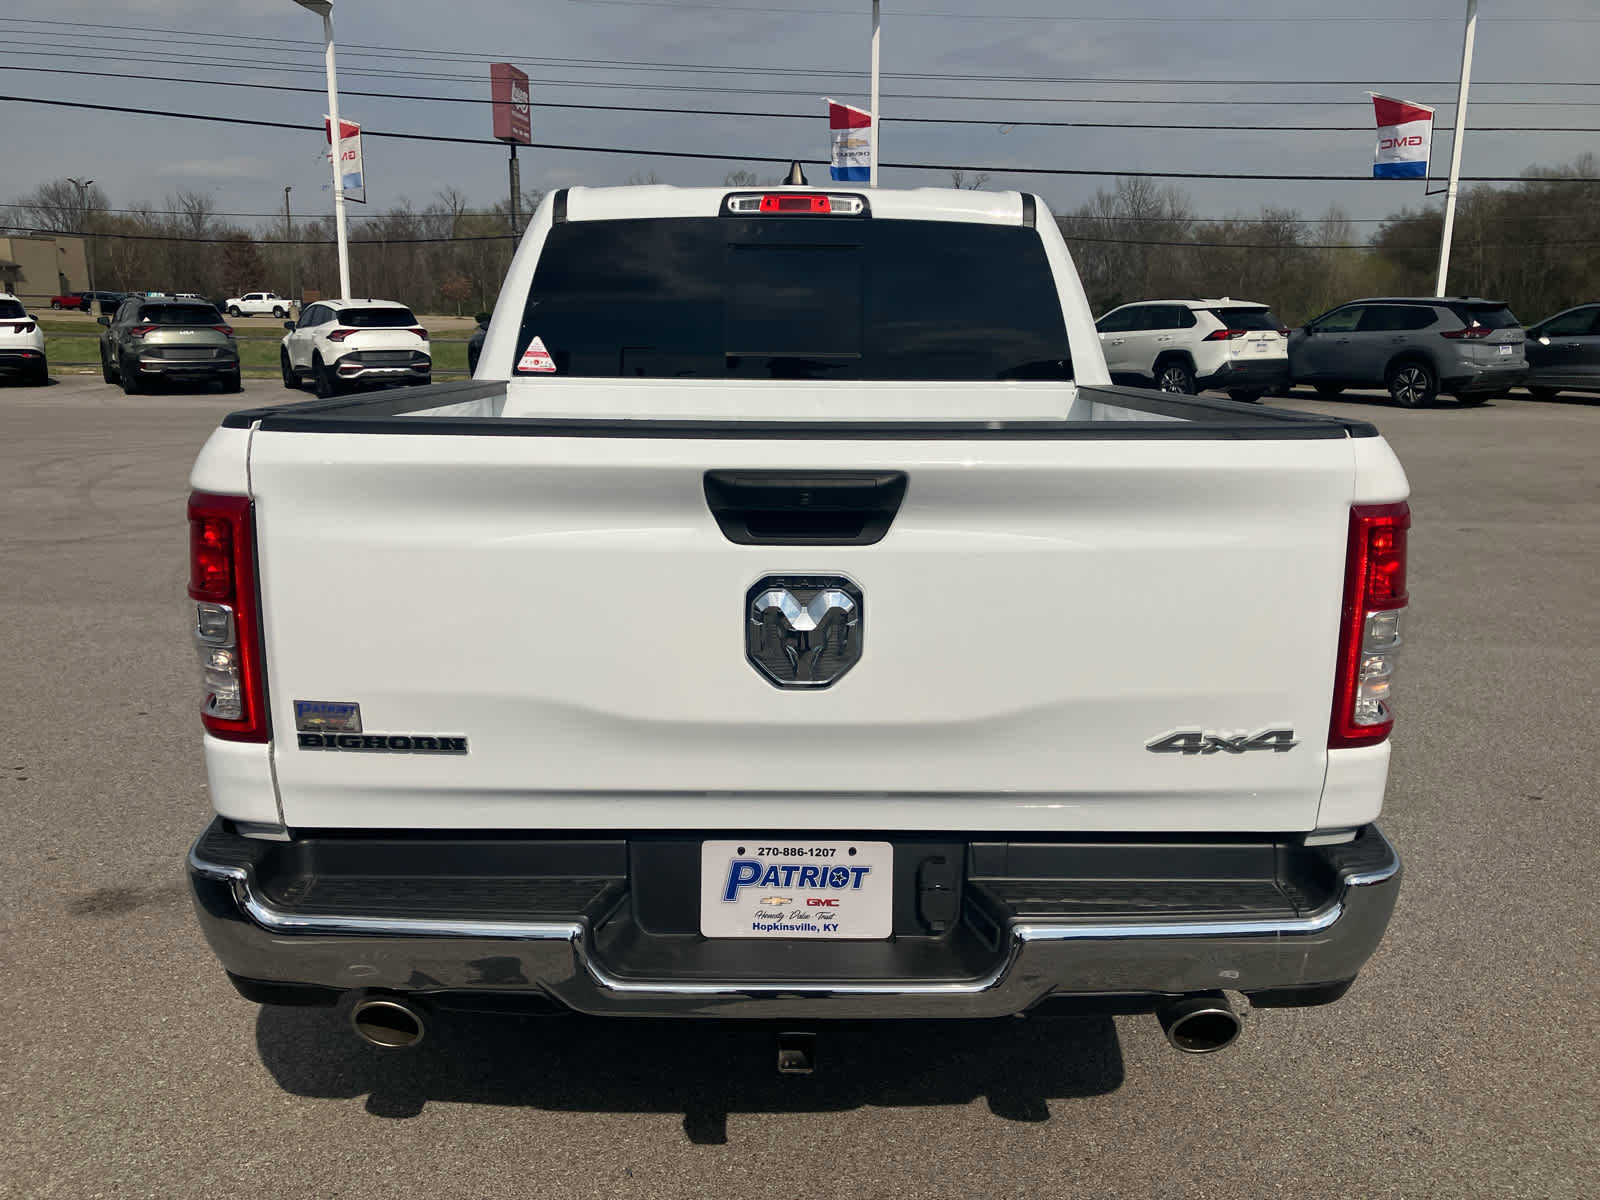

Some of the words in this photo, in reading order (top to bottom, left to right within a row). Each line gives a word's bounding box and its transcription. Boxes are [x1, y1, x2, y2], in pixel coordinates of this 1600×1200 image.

[297, 733, 468, 755] BIGHORN
[758, 847, 837, 857] 270-886-1207
[721, 859, 872, 904] PATRIOT
[806, 898, 840, 907] GMC
[815, 911, 836, 921] Trust
[752, 922, 820, 933] Hopkinsville,
[823, 923, 839, 932] KY
